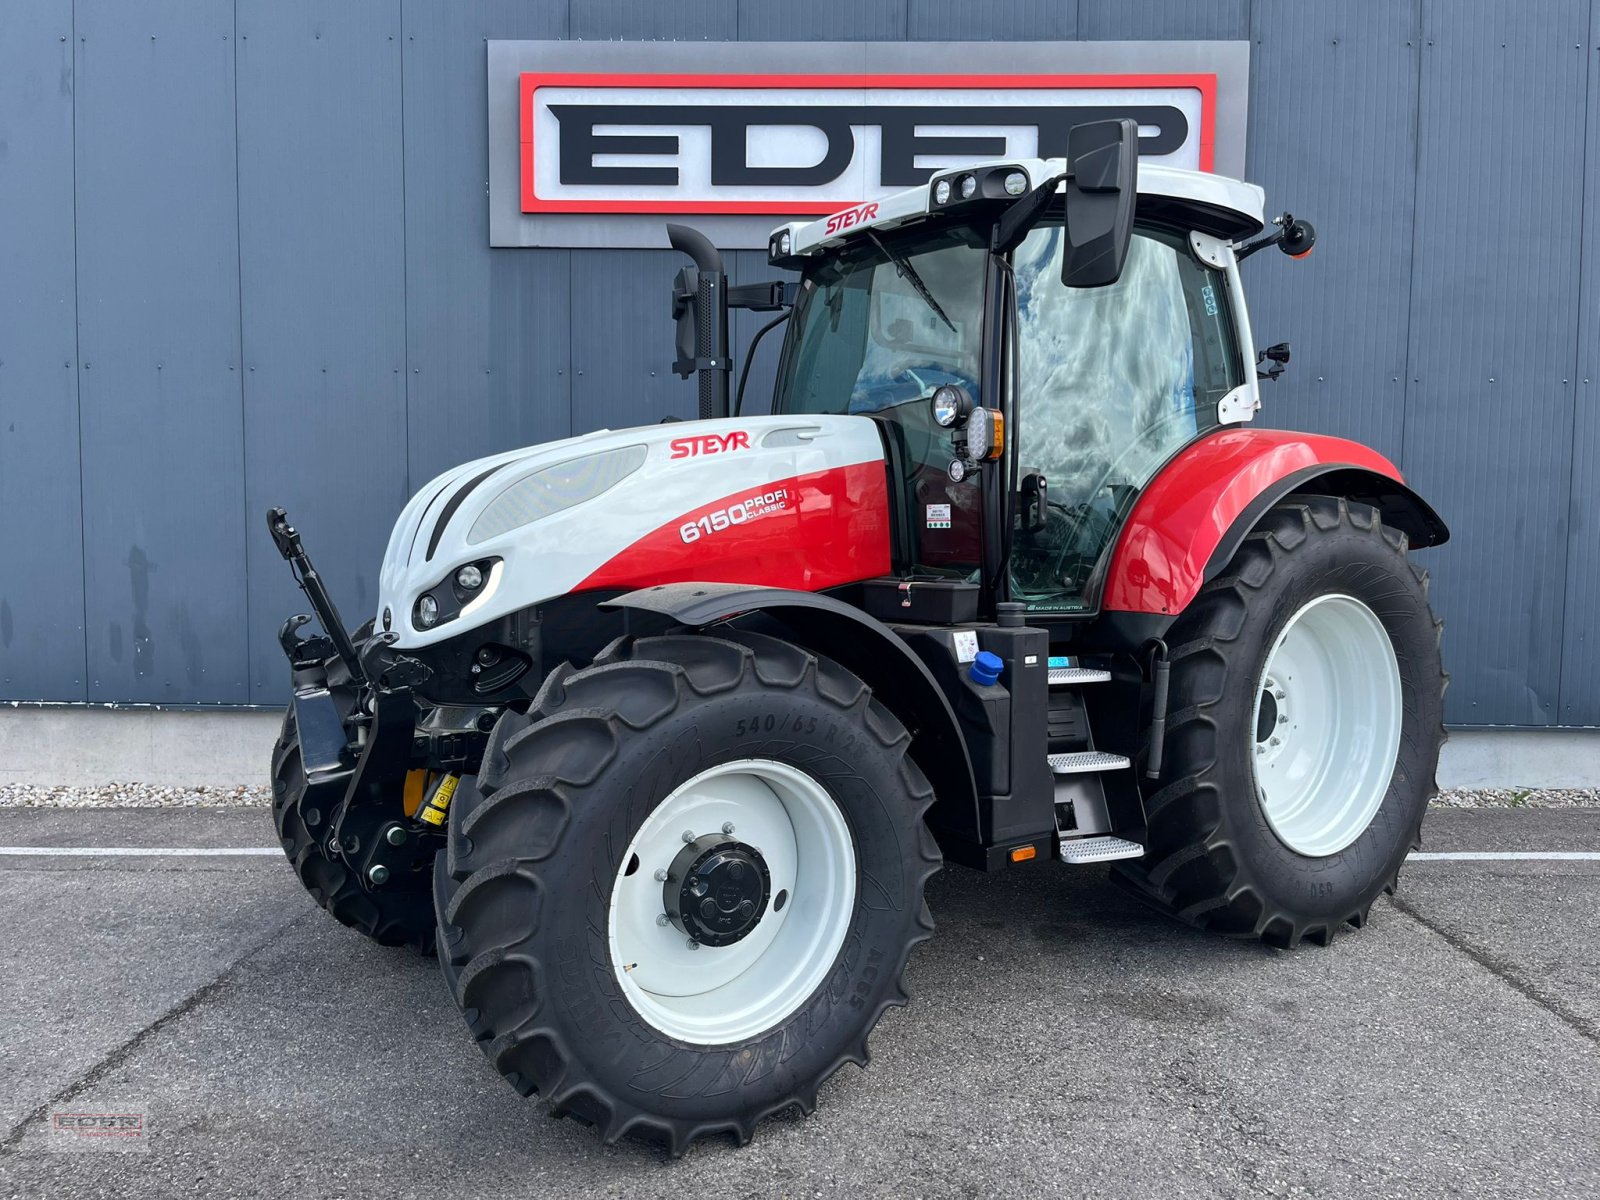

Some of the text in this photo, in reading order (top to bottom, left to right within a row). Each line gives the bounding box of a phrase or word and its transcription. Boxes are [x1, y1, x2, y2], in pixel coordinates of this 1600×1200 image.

[825, 203, 879, 235] STEYR
[670, 430, 750, 459] STEYR
[680, 489, 788, 544] 6150 PROFI
[746, 502, 786, 519] CLASSIC
[735, 712, 818, 738] 540/65
